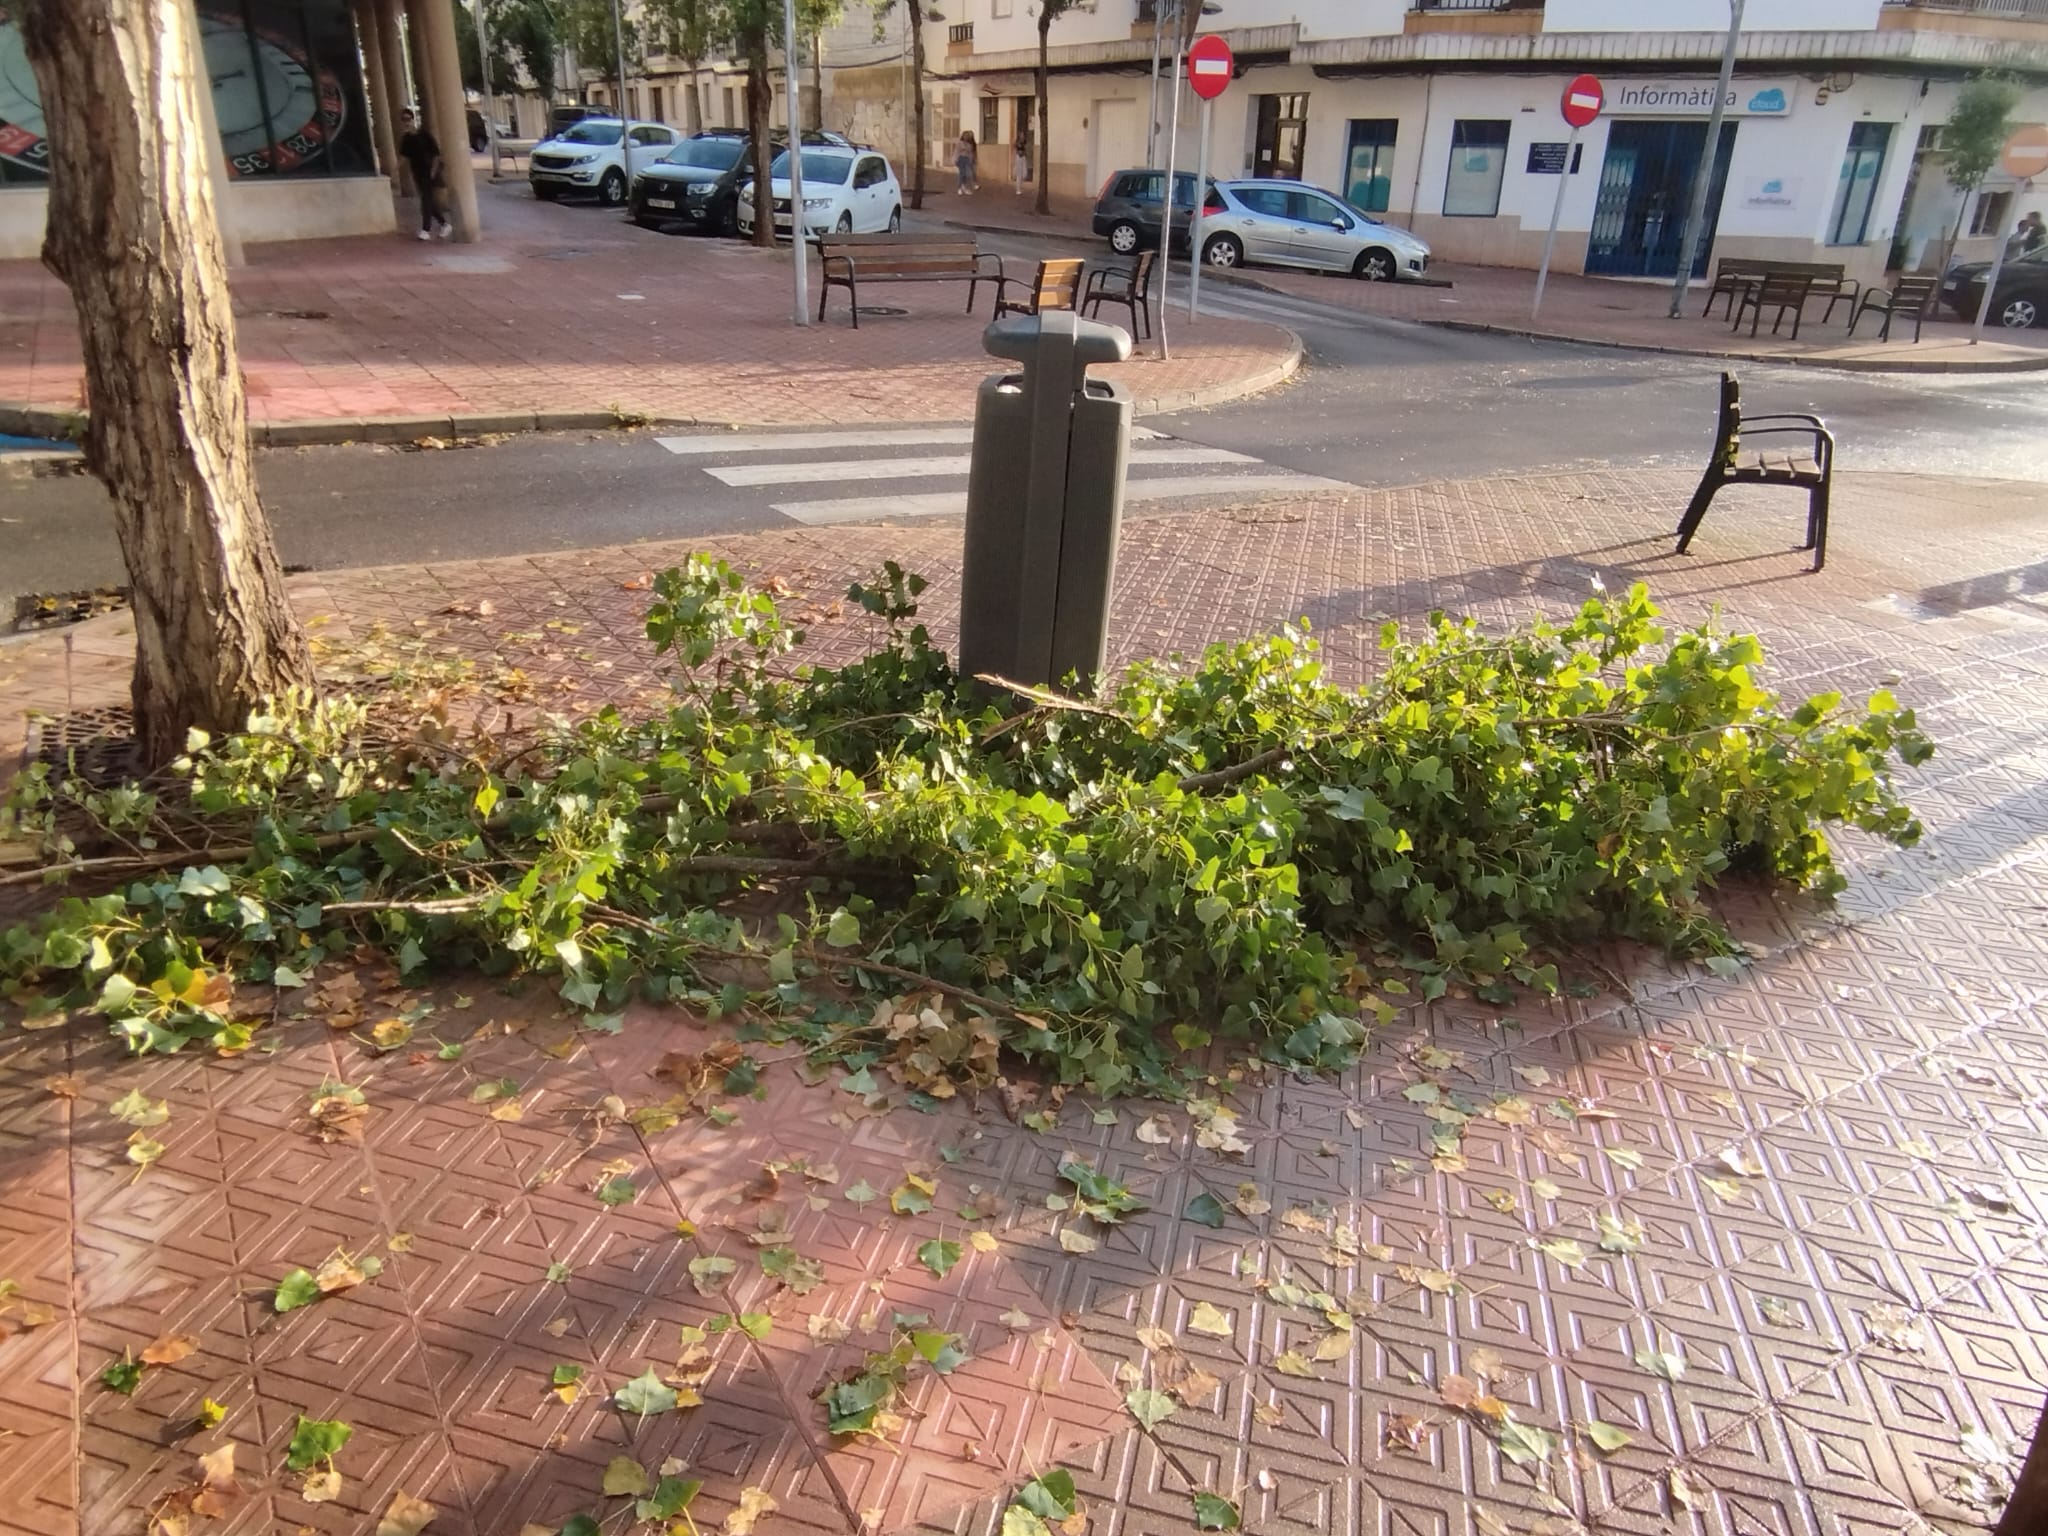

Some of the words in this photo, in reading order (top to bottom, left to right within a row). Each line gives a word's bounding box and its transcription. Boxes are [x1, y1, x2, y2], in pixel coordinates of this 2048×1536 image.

[1619, 85, 1737, 106] Informàtia
[286, 134, 318, 154] 28
[232, 152, 269, 174] 35
